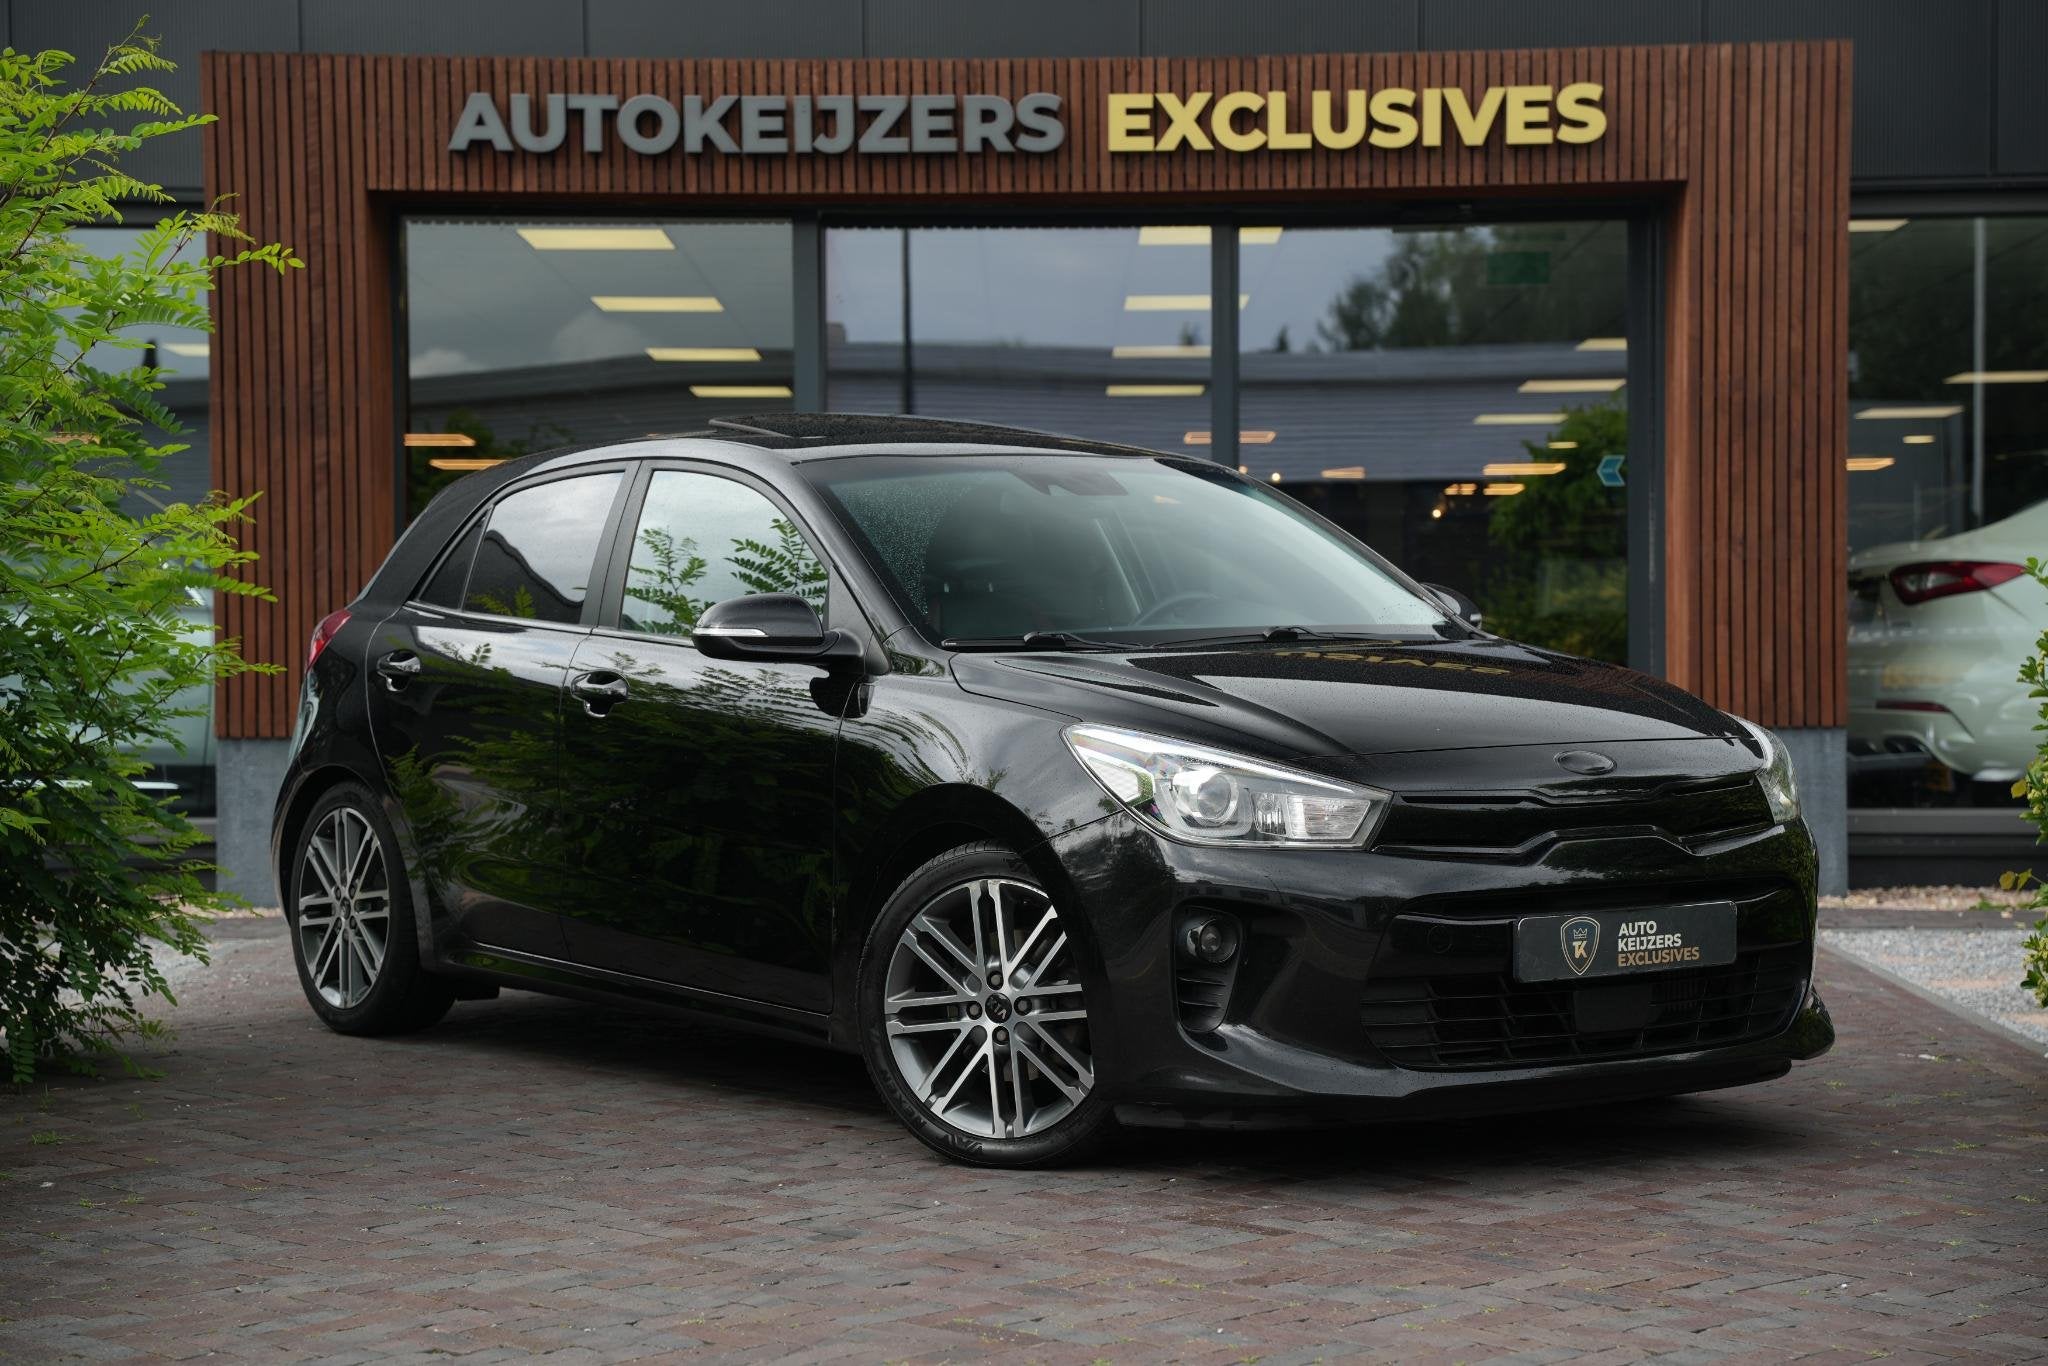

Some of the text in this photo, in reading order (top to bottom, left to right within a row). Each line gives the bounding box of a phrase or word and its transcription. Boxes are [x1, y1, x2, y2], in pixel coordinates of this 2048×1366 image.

[448, 82, 1608, 155] AUTOKEIJZERS EXCLUSIVES
[1618, 921, 1656, 936] AUTO
[1618, 933, 1682, 951] KEIJZERS
[1618, 947, 1700, 966] EXCLUSIVES
